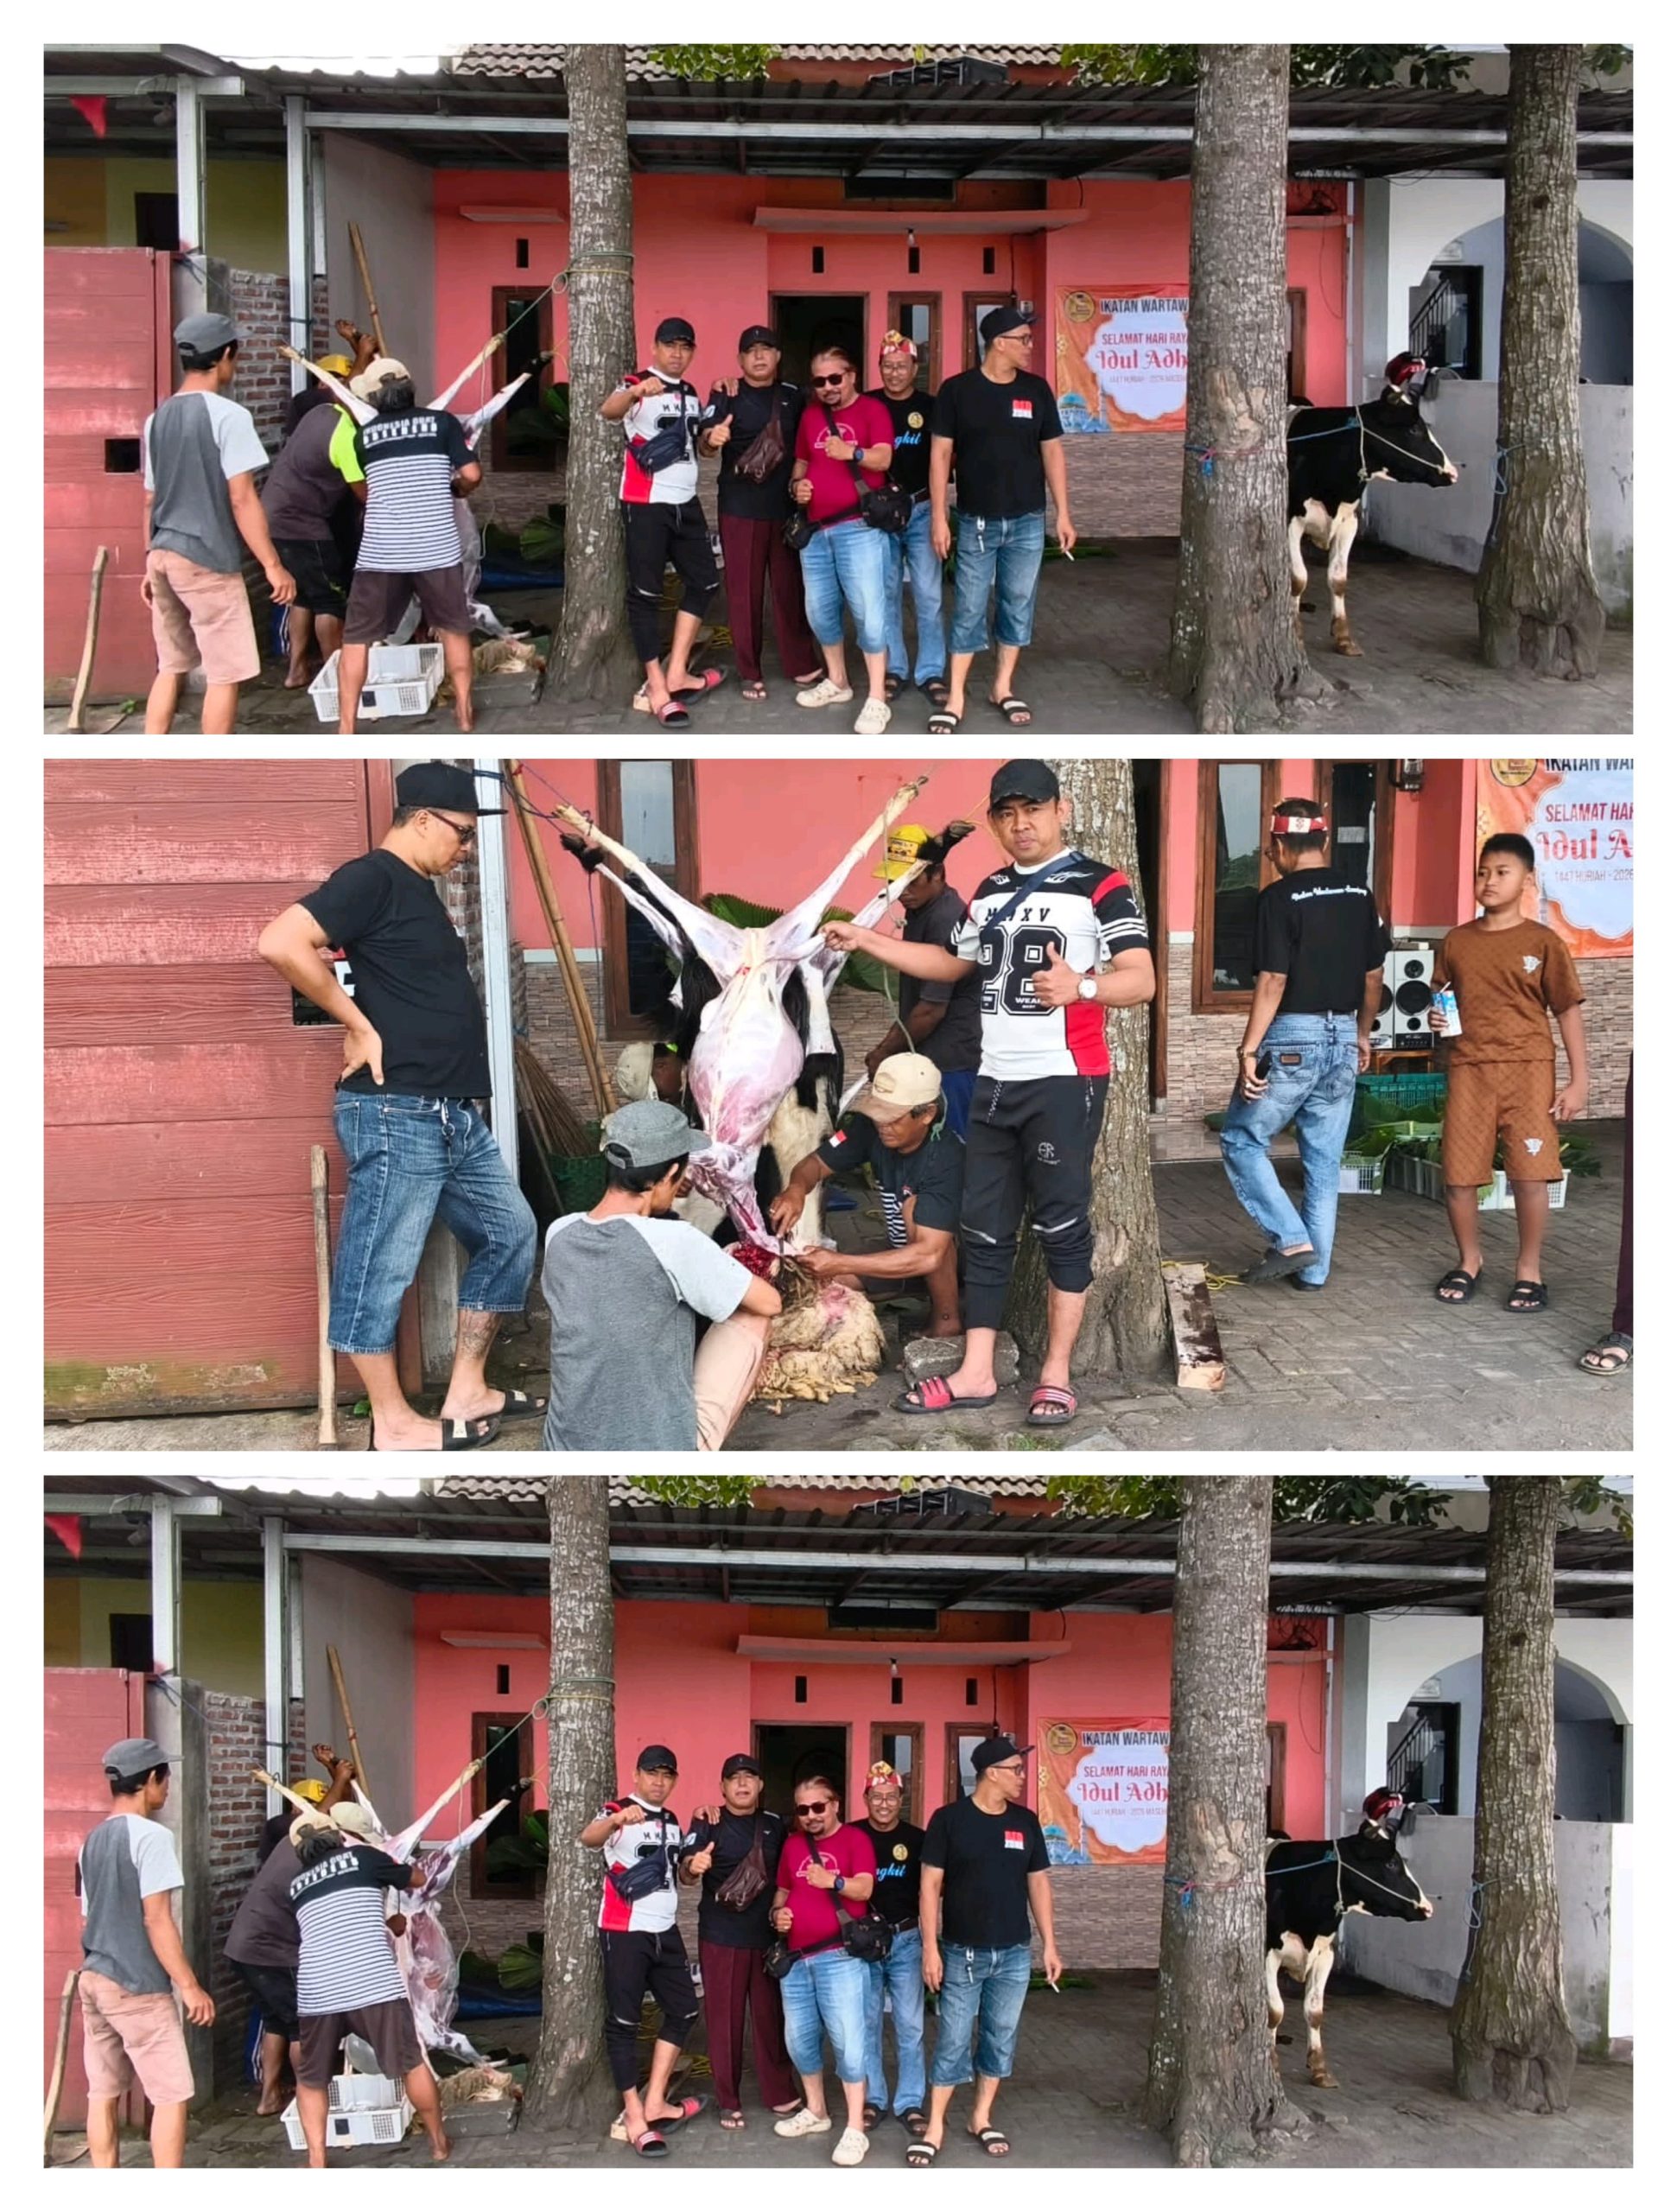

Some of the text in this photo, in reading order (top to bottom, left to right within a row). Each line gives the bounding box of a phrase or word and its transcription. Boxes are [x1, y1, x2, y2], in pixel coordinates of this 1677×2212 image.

[1101, 298, 1137, 313] IKATAN
[1141, 298, 1188, 313] WARTAW
[1102, 333, 1187, 345] SELAMAT HARI RAY
[1096, 350, 1138, 370] Idul
[893, 431, 922, 450] gkit
[1546, 803, 1607, 823] SELAMAT
[1535, 829, 1597, 861] Idul
[985, 907, 1051, 923] MXV
[1083, 1732, 1120, 1746] IKATAN
[1123, 1732, 1170, 1746] WARTAW
[1084, 1765, 1125, 1777] SELAMAT
[1128, 1765, 1148, 1777] HARI
[1077, 1782, 1120, 1802] Idul
